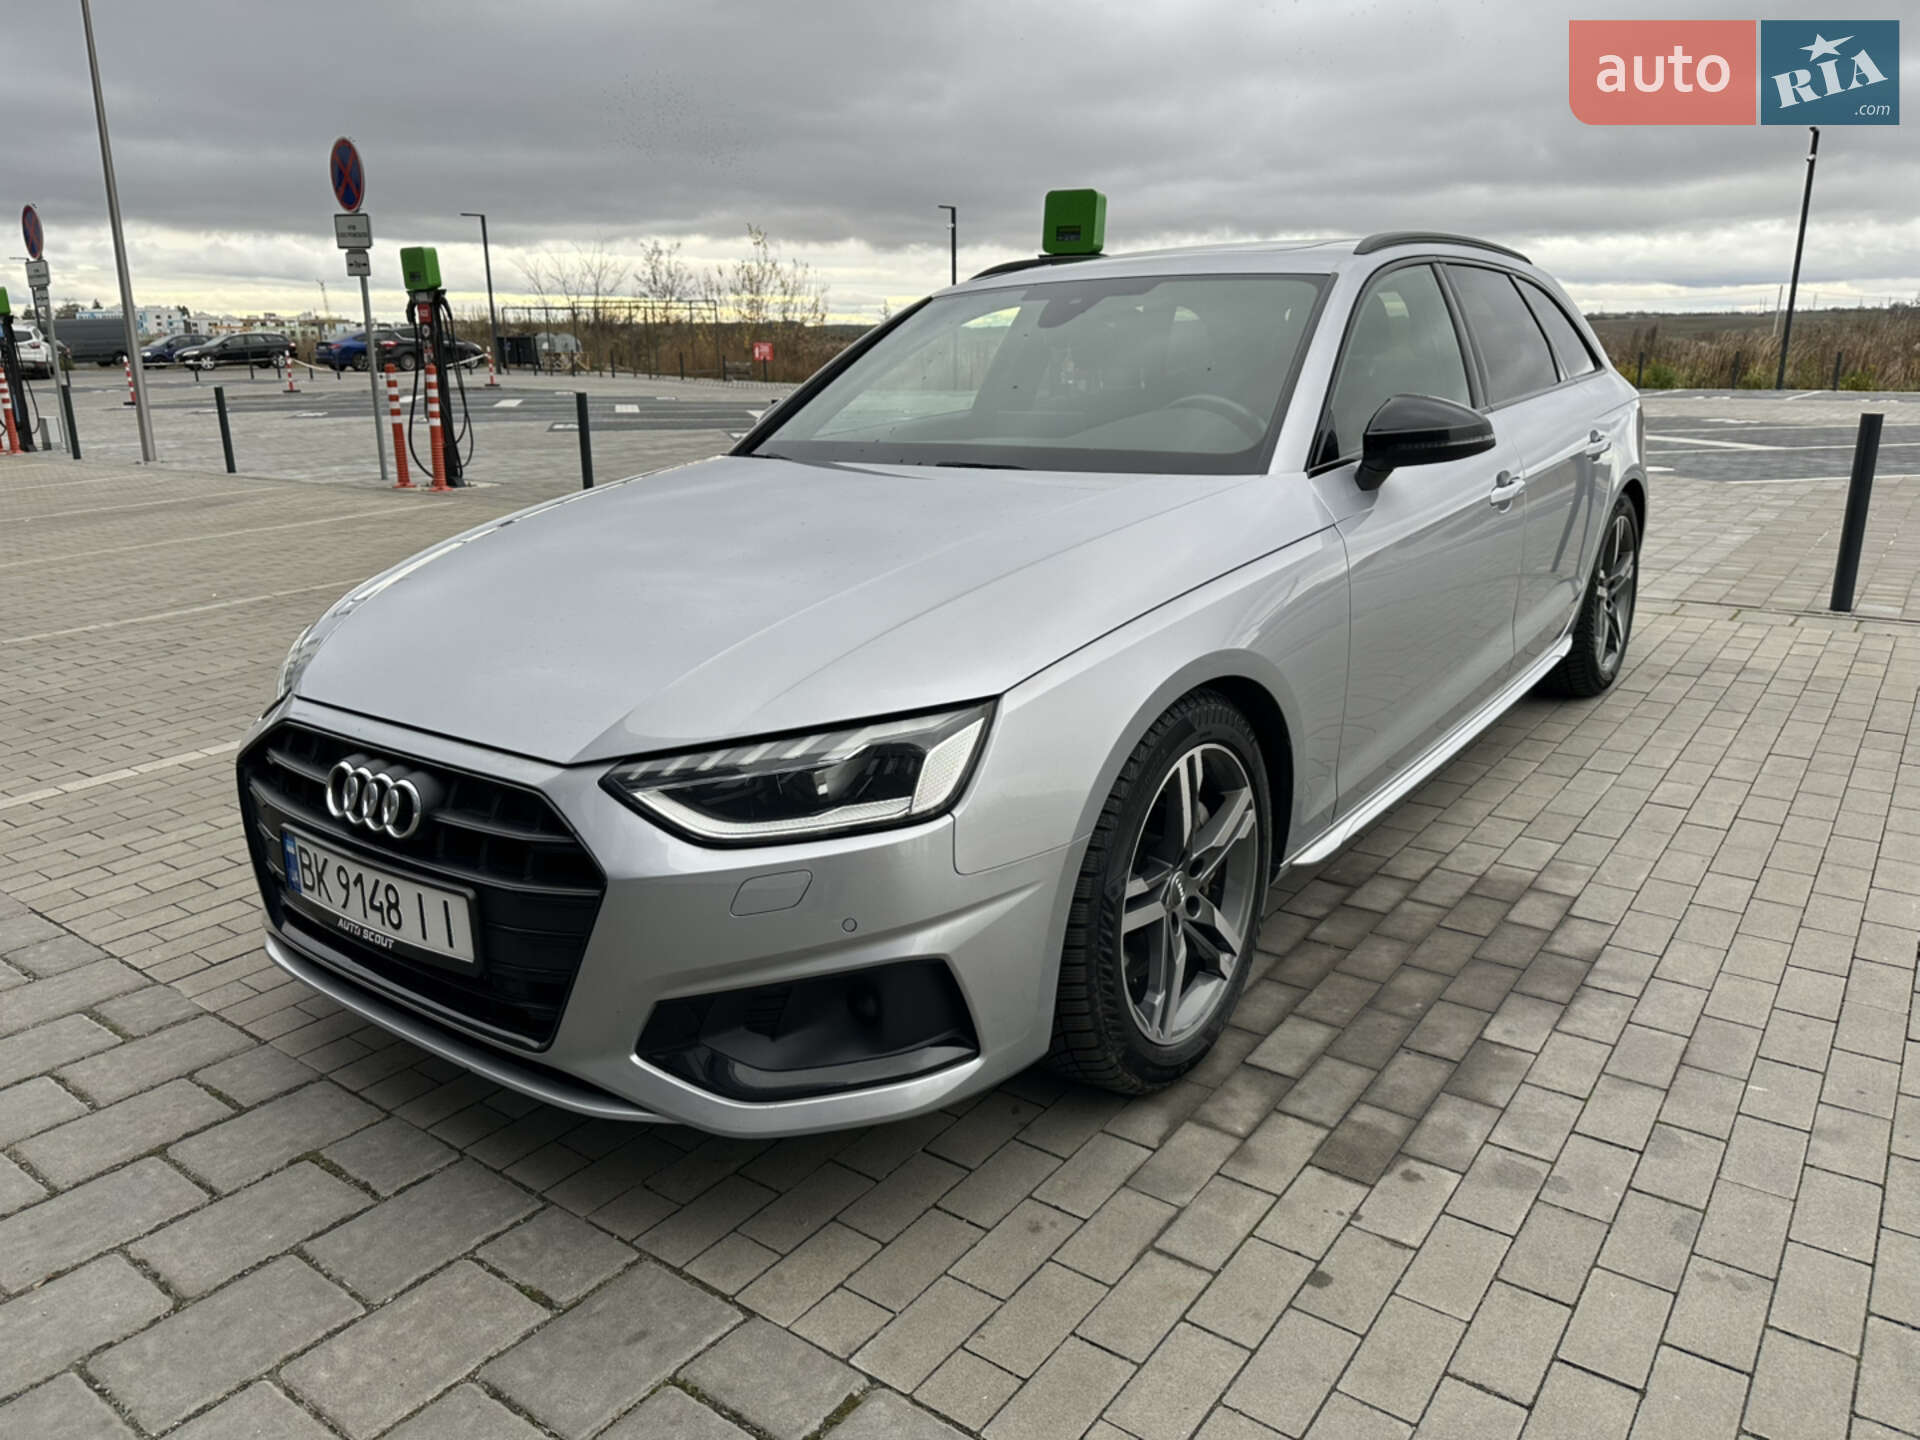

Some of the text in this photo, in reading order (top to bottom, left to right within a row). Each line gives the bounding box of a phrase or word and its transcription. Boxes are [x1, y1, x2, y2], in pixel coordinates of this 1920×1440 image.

[297, 845, 333, 904] BK
[336, 865, 403, 930] 9148
[337, 918, 394, 950] AUTO SCOUT
